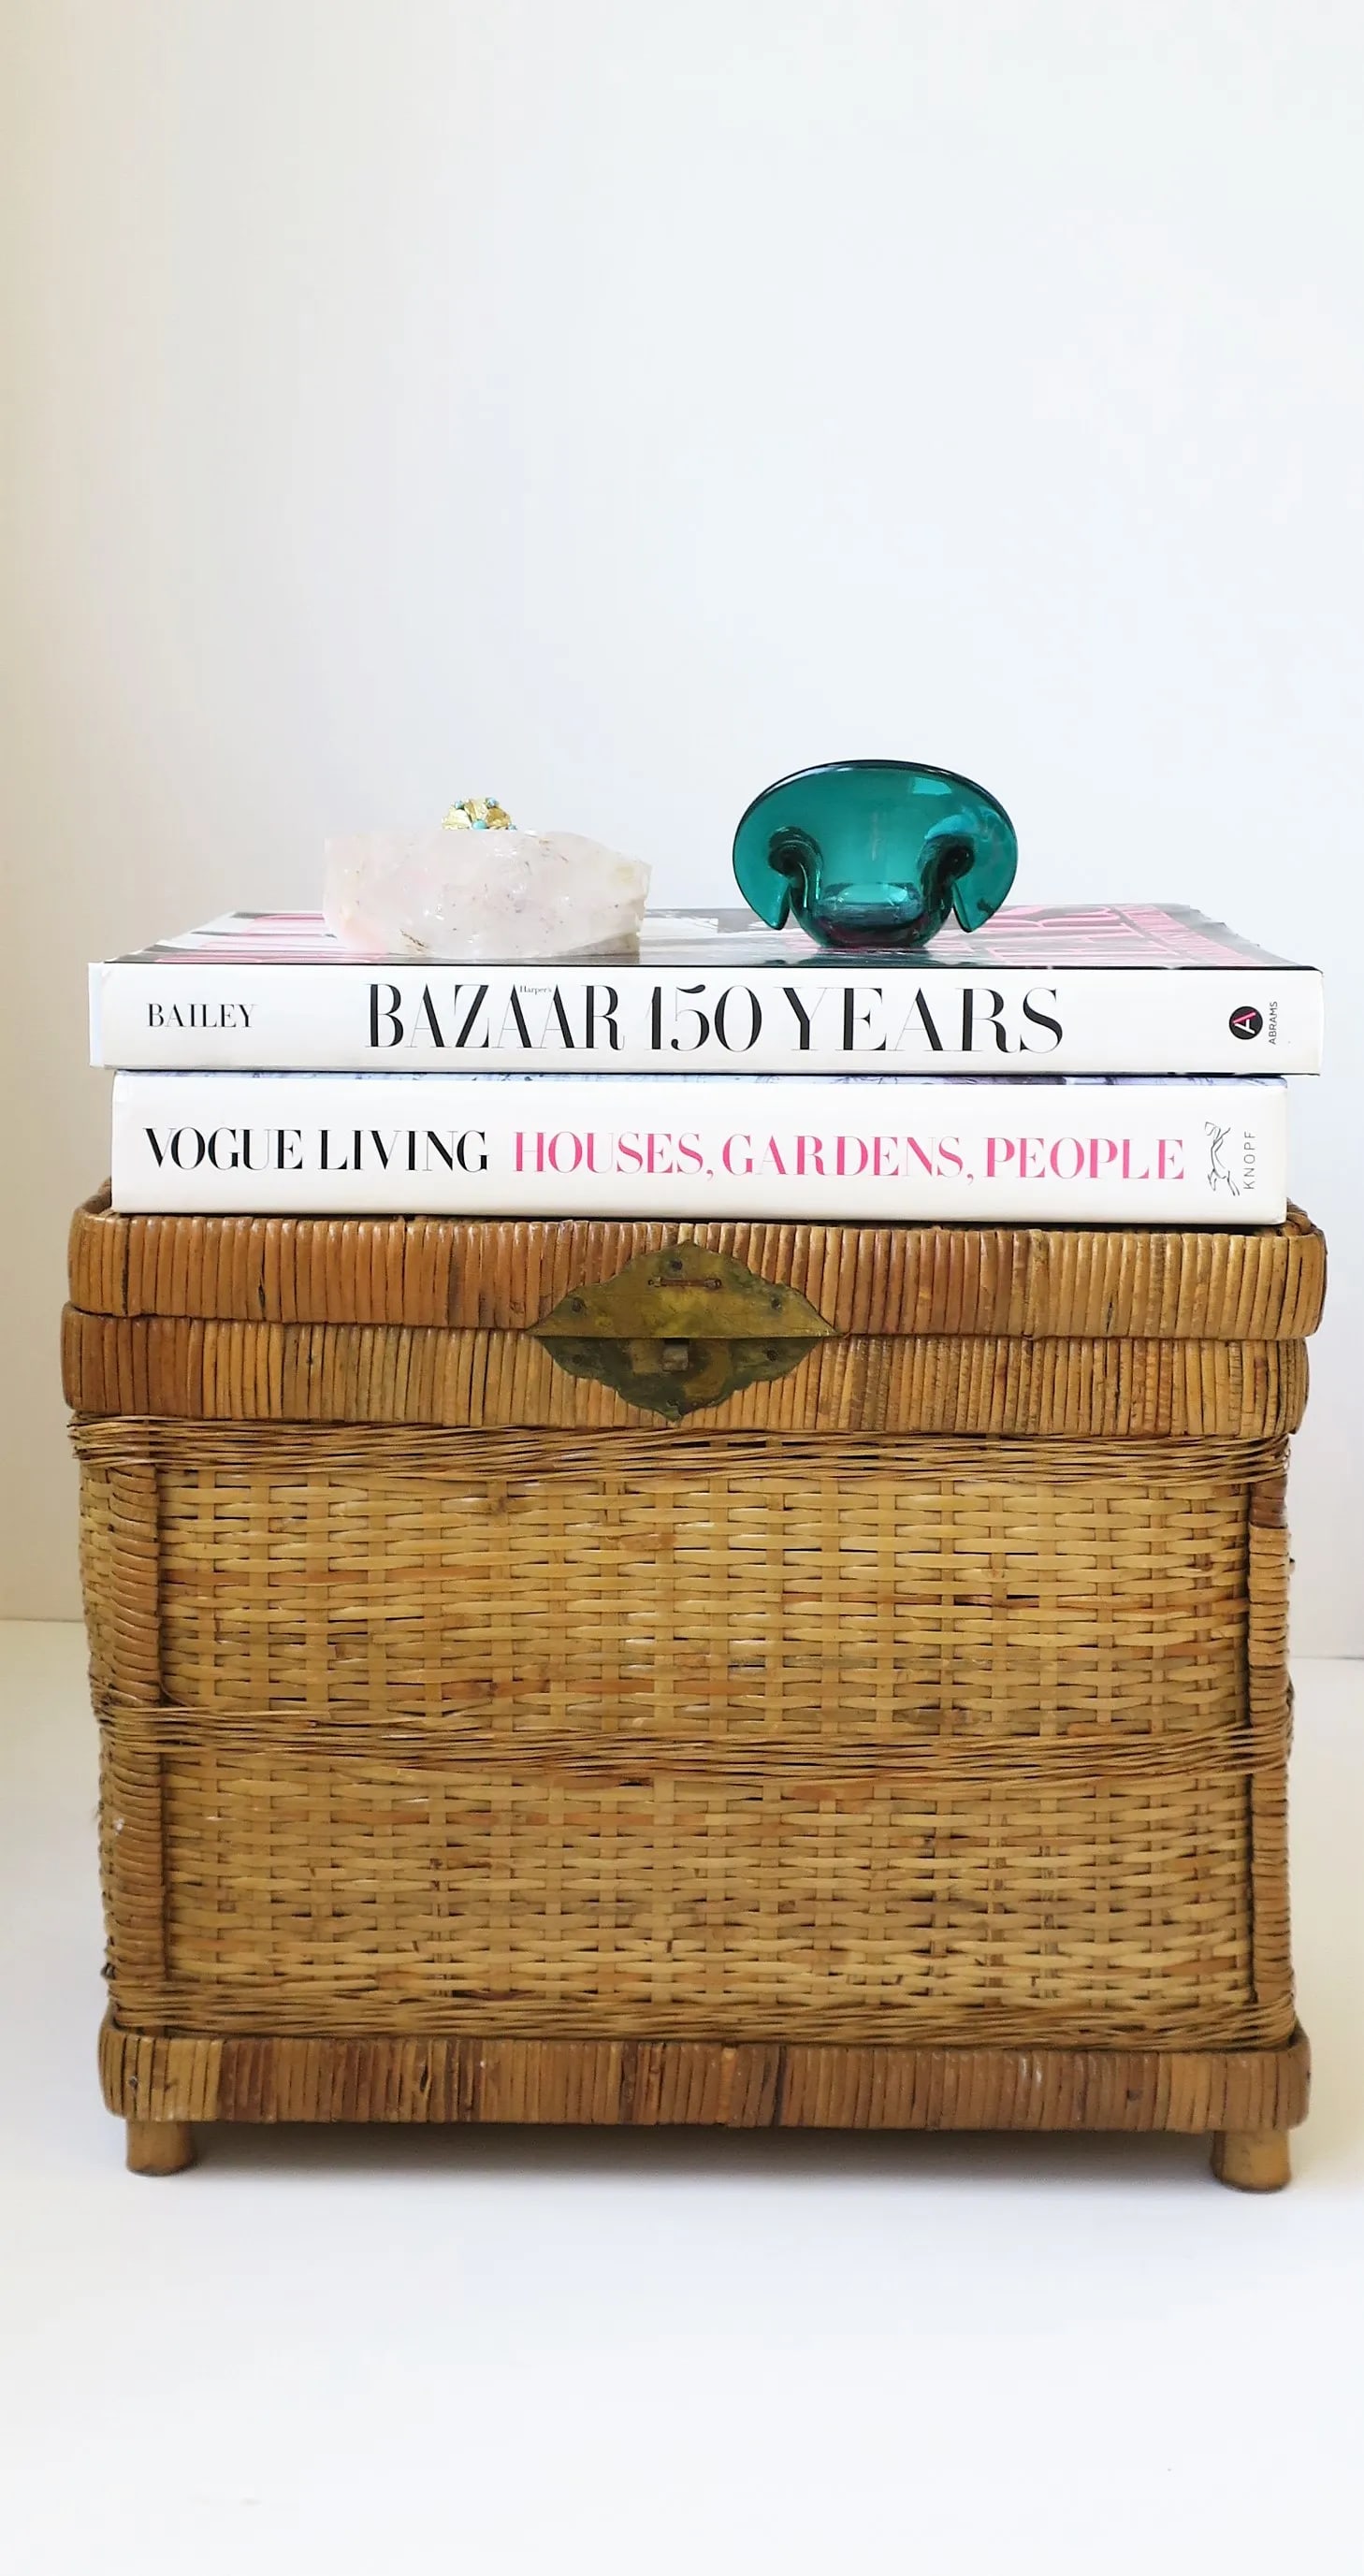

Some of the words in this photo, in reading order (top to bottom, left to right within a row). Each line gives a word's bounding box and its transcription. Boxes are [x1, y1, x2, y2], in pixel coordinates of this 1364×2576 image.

[147, 1003, 256, 1028] BAILEY
[365, 983, 625, 1050] BAZAAR
[646, 984, 762, 1052] 150
[774, 987, 1064, 1054] YEARS
[1268, 1001, 1278, 1045] ABRAMS
[142, 1127, 303, 1171] VOGUE
[317, 1129, 489, 1173] LIVING
[513, 1131, 715, 1180] HOUSES,
[721, 1134, 975, 1184] GARDENS,
[985, 1137, 1185, 1180] PEOPLE
[1243, 1130, 1255, 1190] KNOPF
